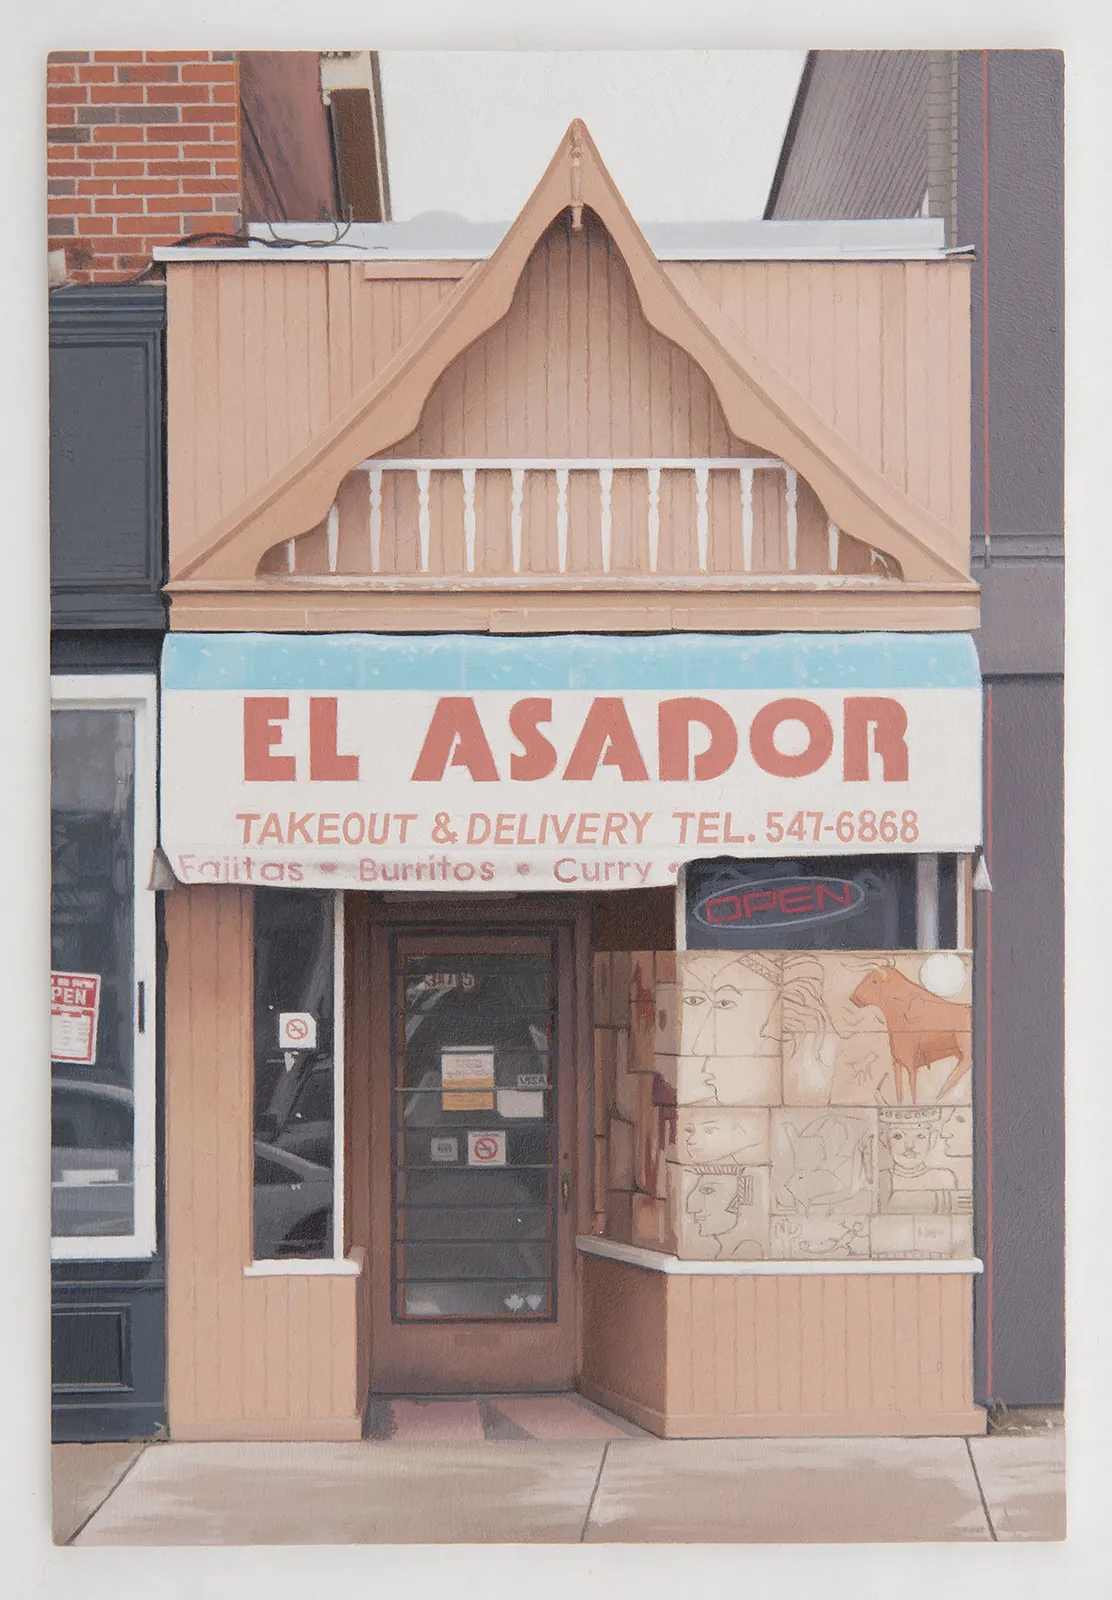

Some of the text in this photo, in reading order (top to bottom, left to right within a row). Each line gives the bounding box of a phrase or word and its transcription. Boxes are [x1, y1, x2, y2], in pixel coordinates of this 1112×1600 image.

[243, 696, 910, 782] EL ASADOR
[235, 809, 921, 846] TAKEOUT & DELIVERY TEL. 547-6868
[177, 853, 654, 885] Fajitas Burritos Curry
[705, 882, 853, 923] OPEN
